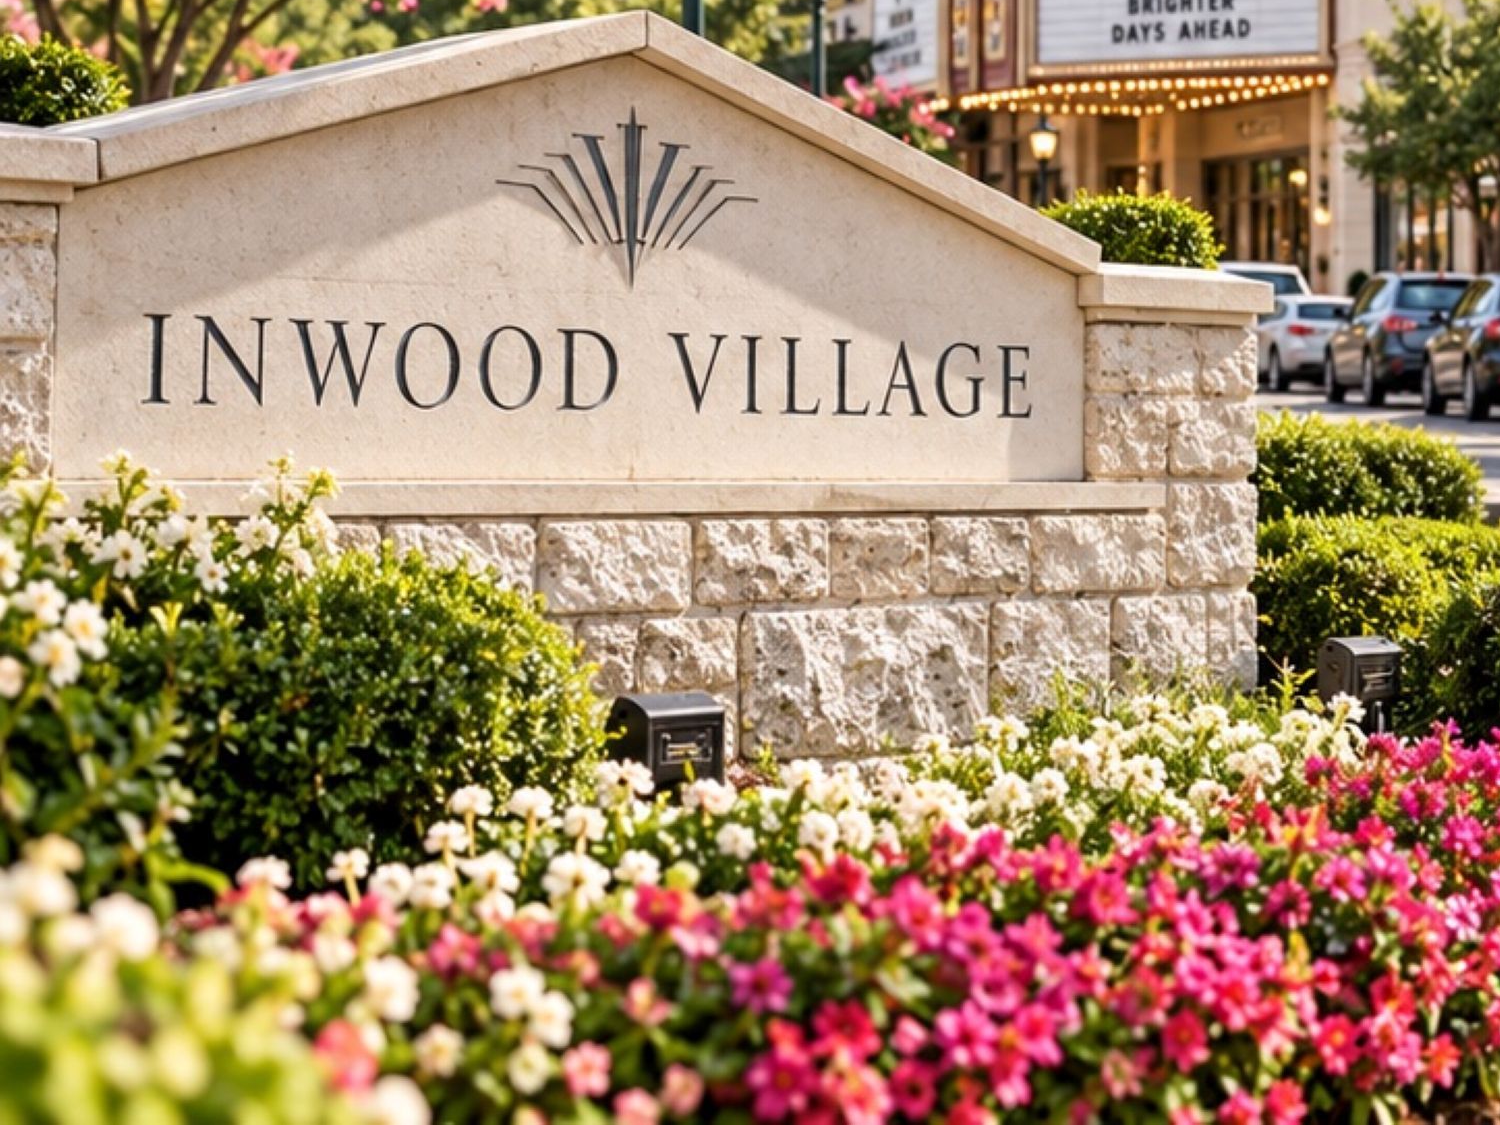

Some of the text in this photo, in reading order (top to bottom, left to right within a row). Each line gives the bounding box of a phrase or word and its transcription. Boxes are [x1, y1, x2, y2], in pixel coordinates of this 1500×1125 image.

[1111, 18, 1251, 44] DAYS AHEAD
[141, 312, 1033, 420] INWOOD VILLAGE
